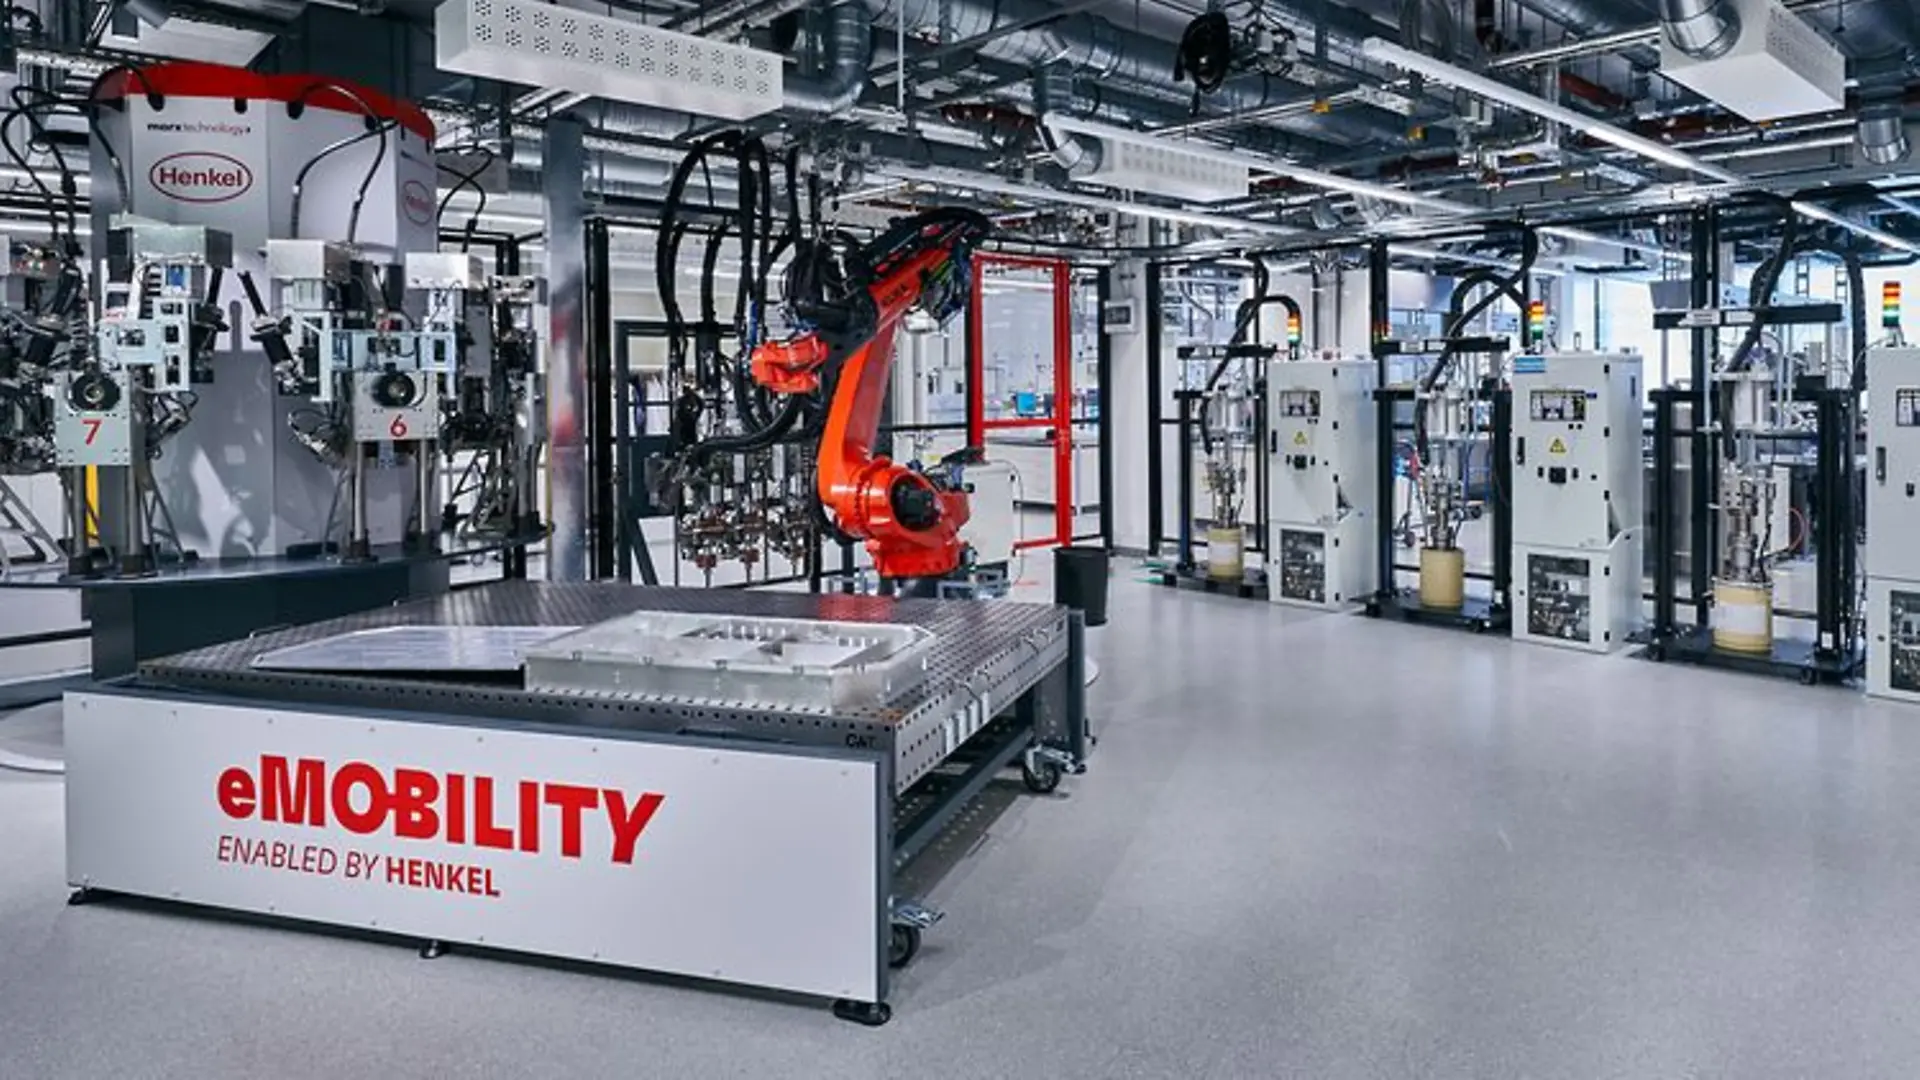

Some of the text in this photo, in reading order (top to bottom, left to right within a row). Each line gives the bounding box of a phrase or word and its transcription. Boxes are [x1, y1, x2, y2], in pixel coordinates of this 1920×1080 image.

[159, 167, 243, 187] Henkel
[81, 418, 103, 446] 7
[389, 414, 408, 437] 6
[216, 754, 666, 865] eMOBILITY
[217, 834, 500, 898] ENABLED BY HENKEL
